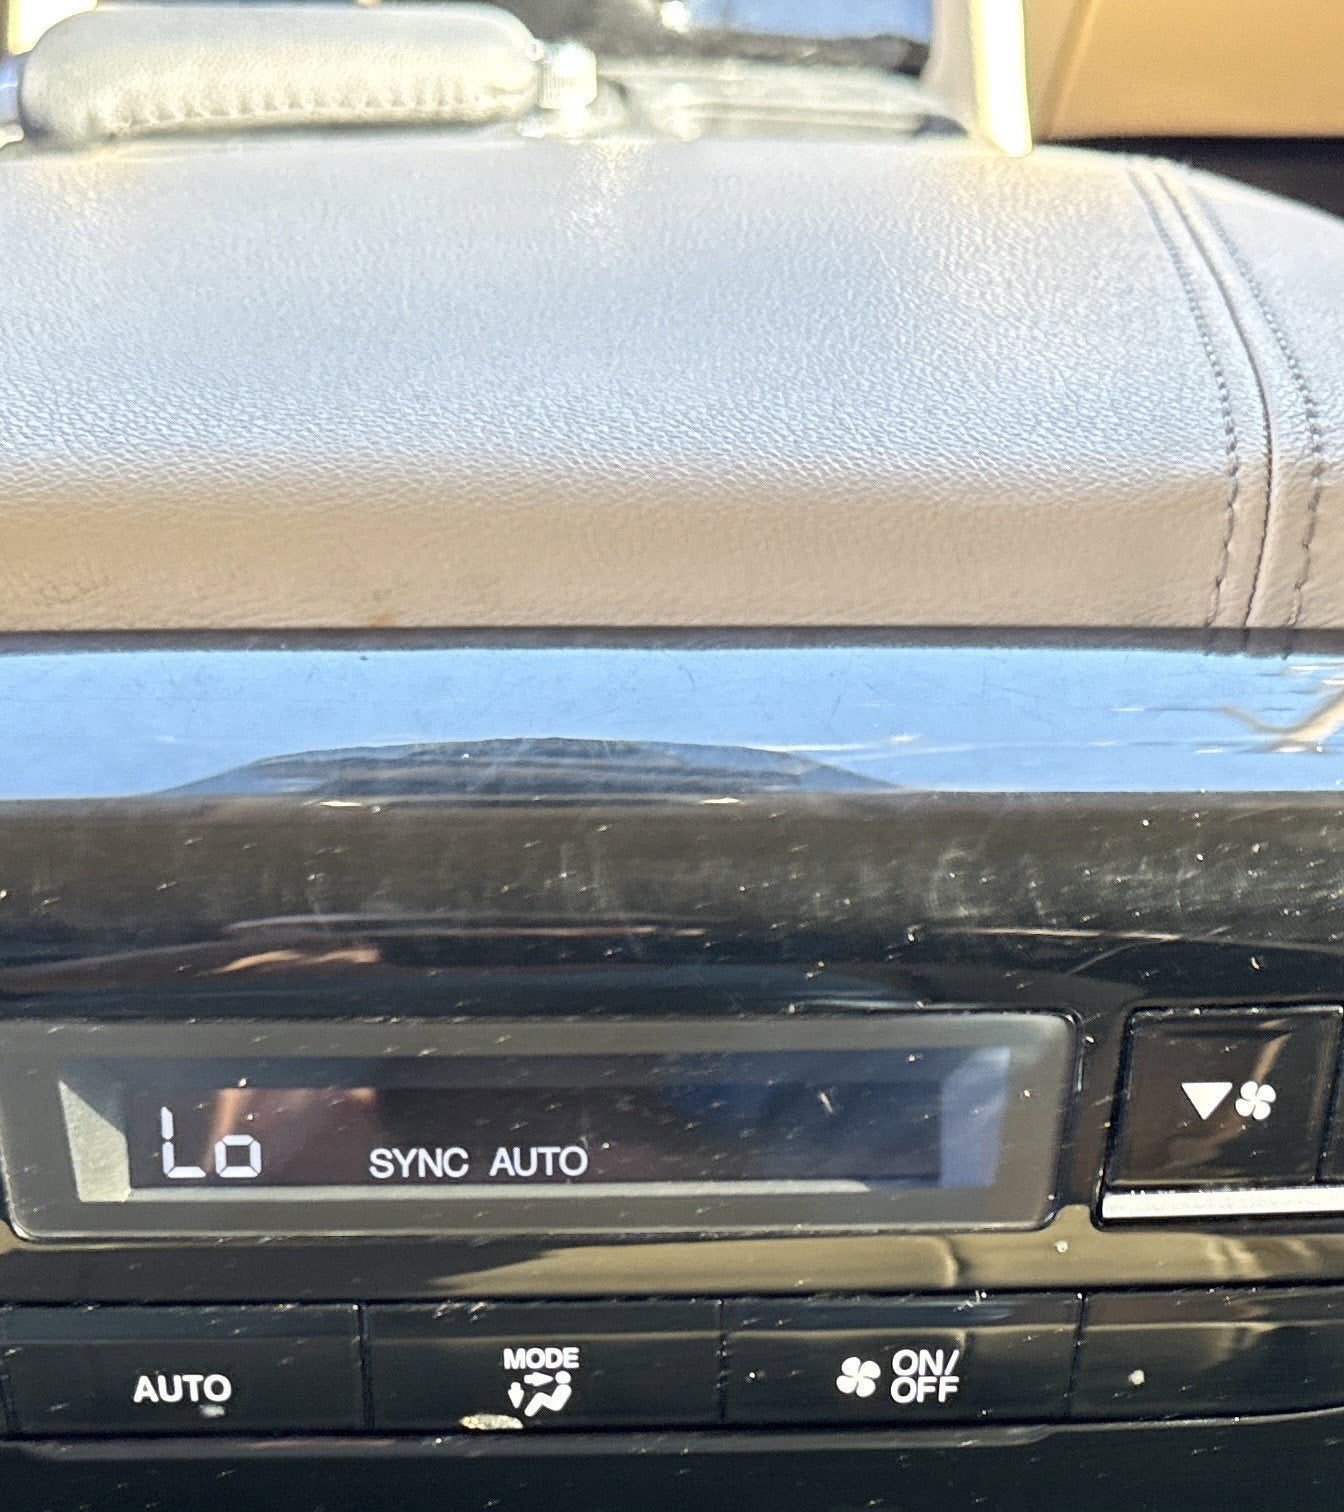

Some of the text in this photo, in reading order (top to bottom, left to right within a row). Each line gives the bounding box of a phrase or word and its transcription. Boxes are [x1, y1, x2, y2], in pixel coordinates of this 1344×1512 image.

[368, 1145, 589, 1180] SYNC AUTO
[503, 1346, 580, 1371] MODE
[890, 1349, 961, 1380] ON/
[132, 1373, 232, 1405] AUTO
[890, 1373, 960, 1404] OFF
